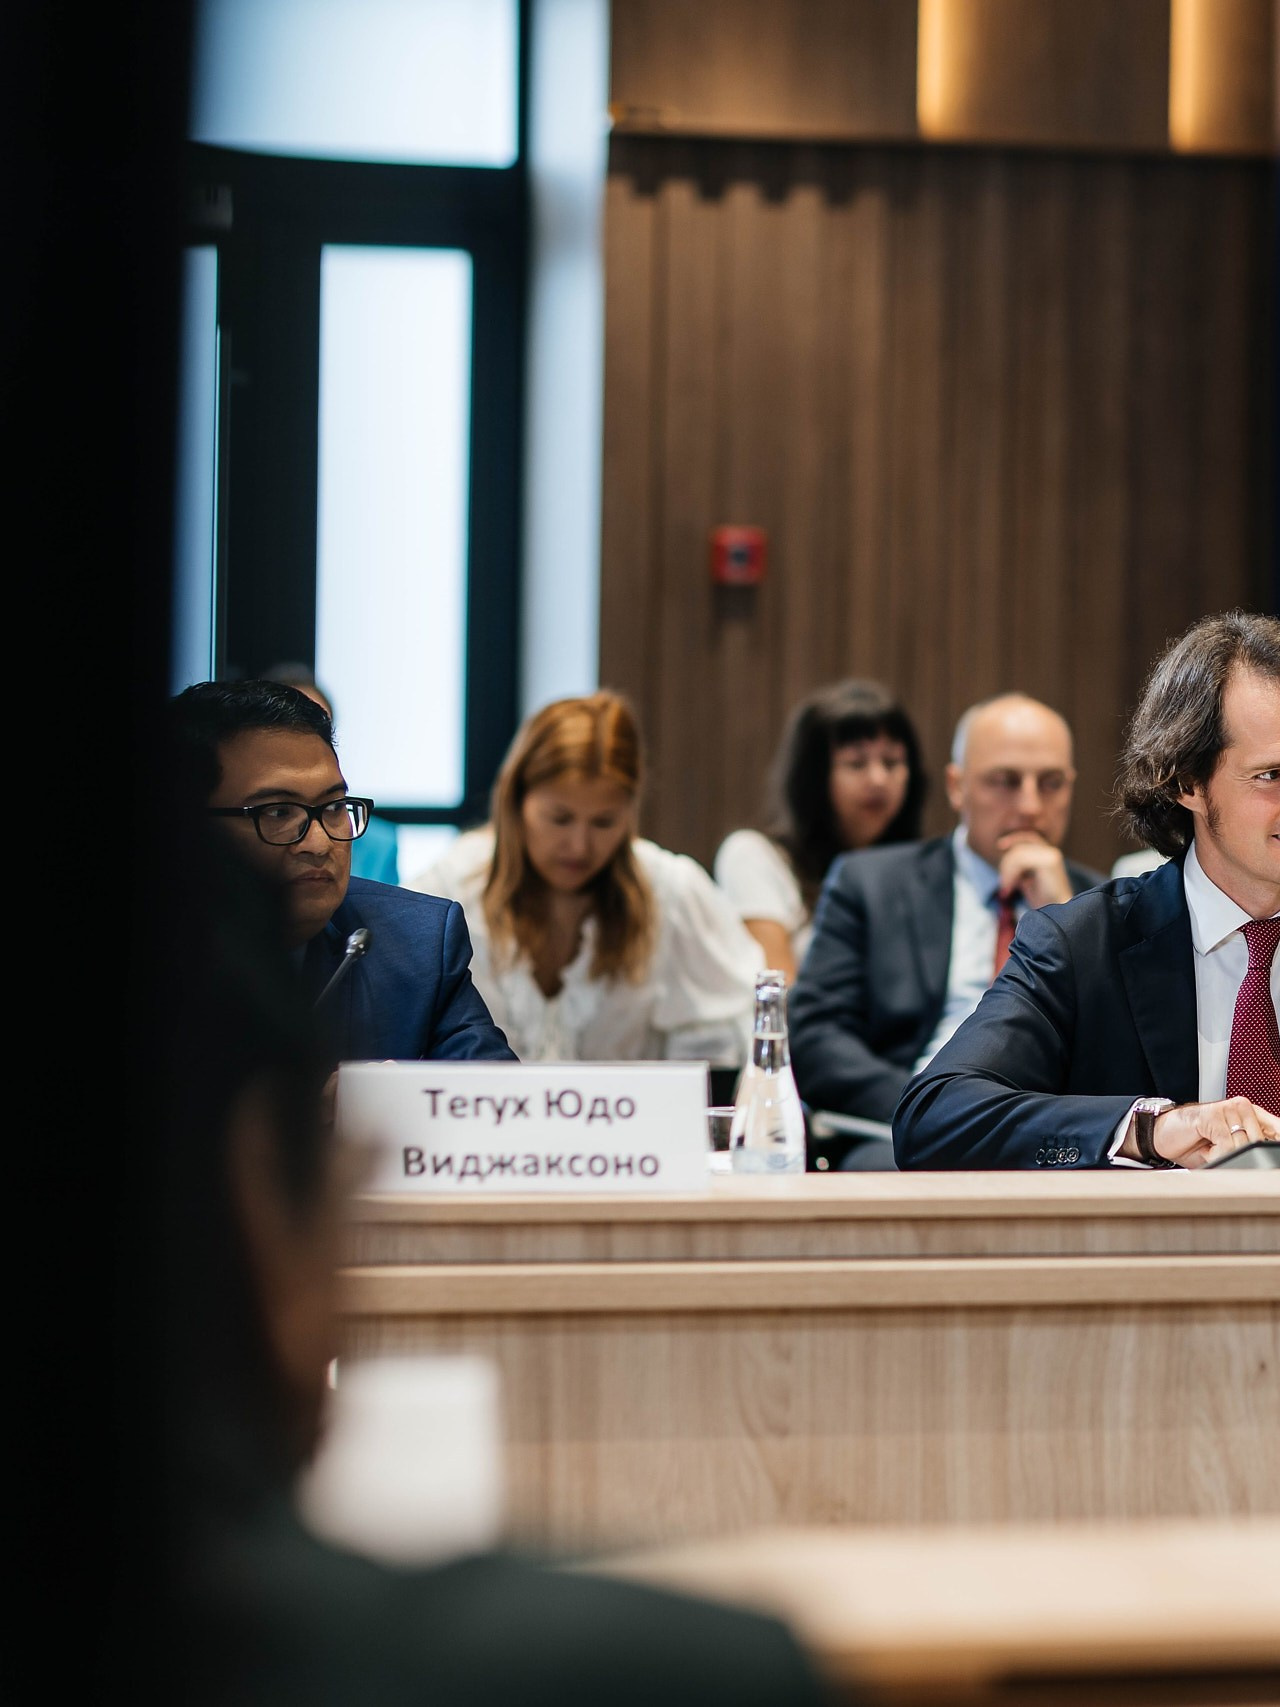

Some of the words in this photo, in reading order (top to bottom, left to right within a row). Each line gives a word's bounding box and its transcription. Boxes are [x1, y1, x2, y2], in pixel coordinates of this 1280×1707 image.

[421, 1087, 530, 1126] Тегух
[544, 1088, 637, 1125] Юдо
[402, 1146, 660, 1181] Виджаксоно
